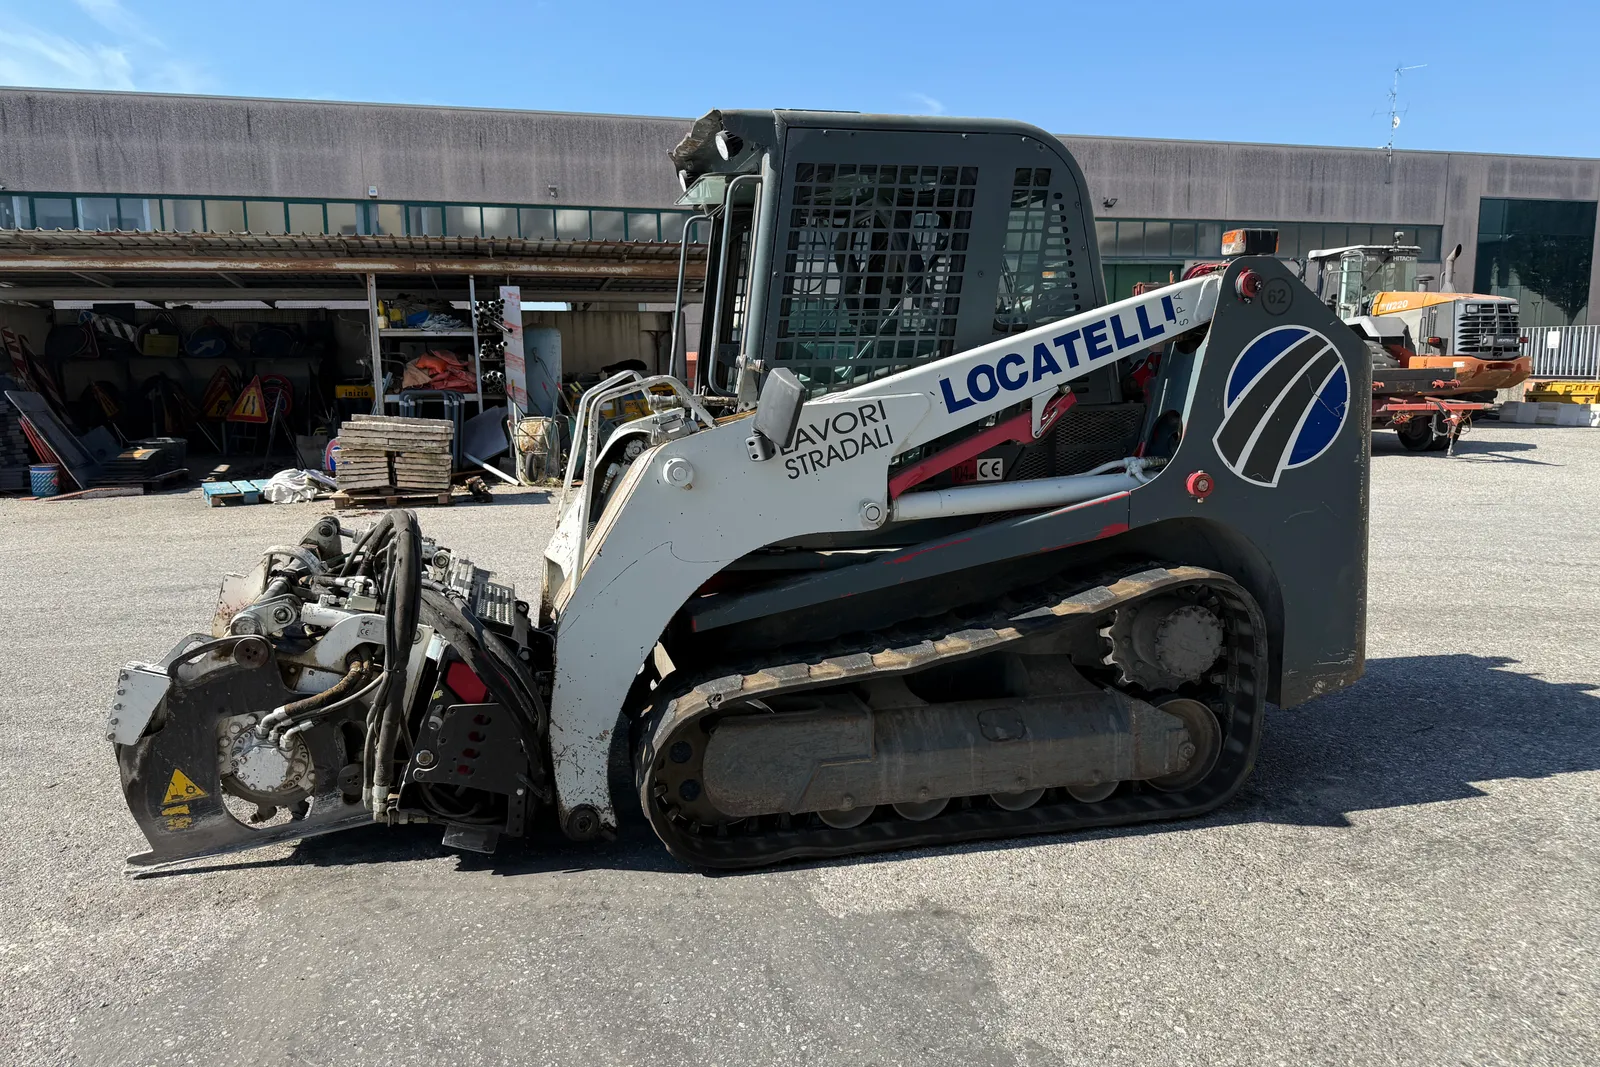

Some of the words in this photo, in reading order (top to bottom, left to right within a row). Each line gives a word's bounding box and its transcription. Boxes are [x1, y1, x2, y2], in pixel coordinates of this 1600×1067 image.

[1268, 288, 1286, 304] 62
[939, 295, 1177, 414] LOCATELLI
[345, 389, 369, 397] inizio
[784, 424, 894, 480] STRADALI
[979, 461, 1000, 478] CE
